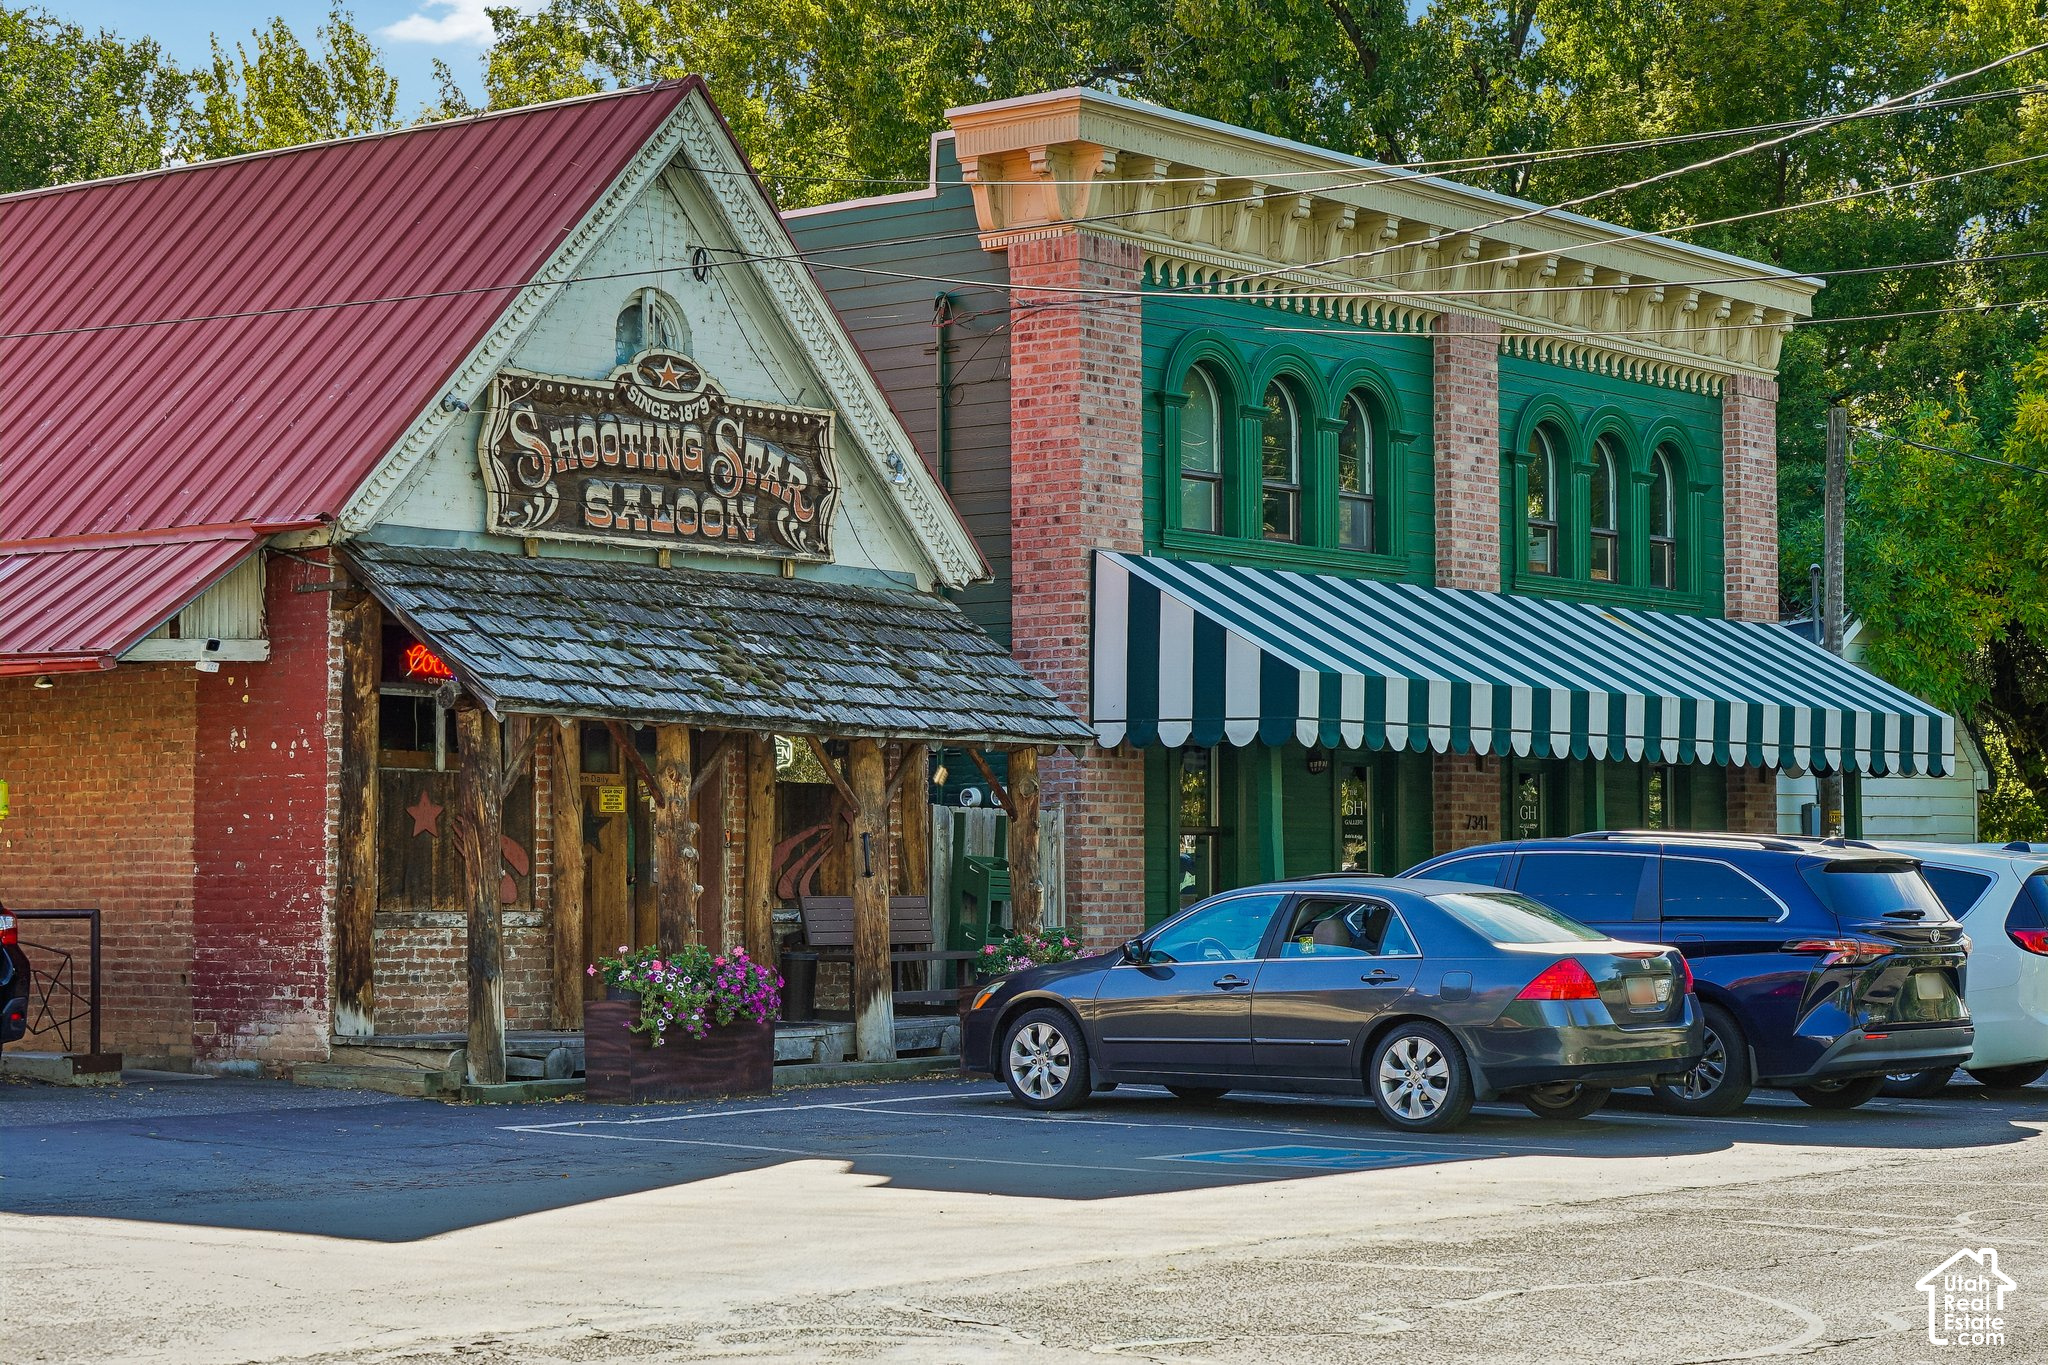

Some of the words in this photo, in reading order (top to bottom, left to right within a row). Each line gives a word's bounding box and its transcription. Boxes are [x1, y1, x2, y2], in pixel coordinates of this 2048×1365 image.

[627, 385, 670, 420] SINCE
[679, 396, 710, 422] 1879
[509, 404, 704, 489] SHOOTING
[709, 417, 815, 523] STAR
[584, 484, 757, 543] SALOON
[776, 746, 790, 760] EN
[591, 774, 609, 784] Daily
[1344, 800, 1363, 816] GH
[1519, 805, 1537, 820] GH
[1465, 814, 1488, 831] 7341
